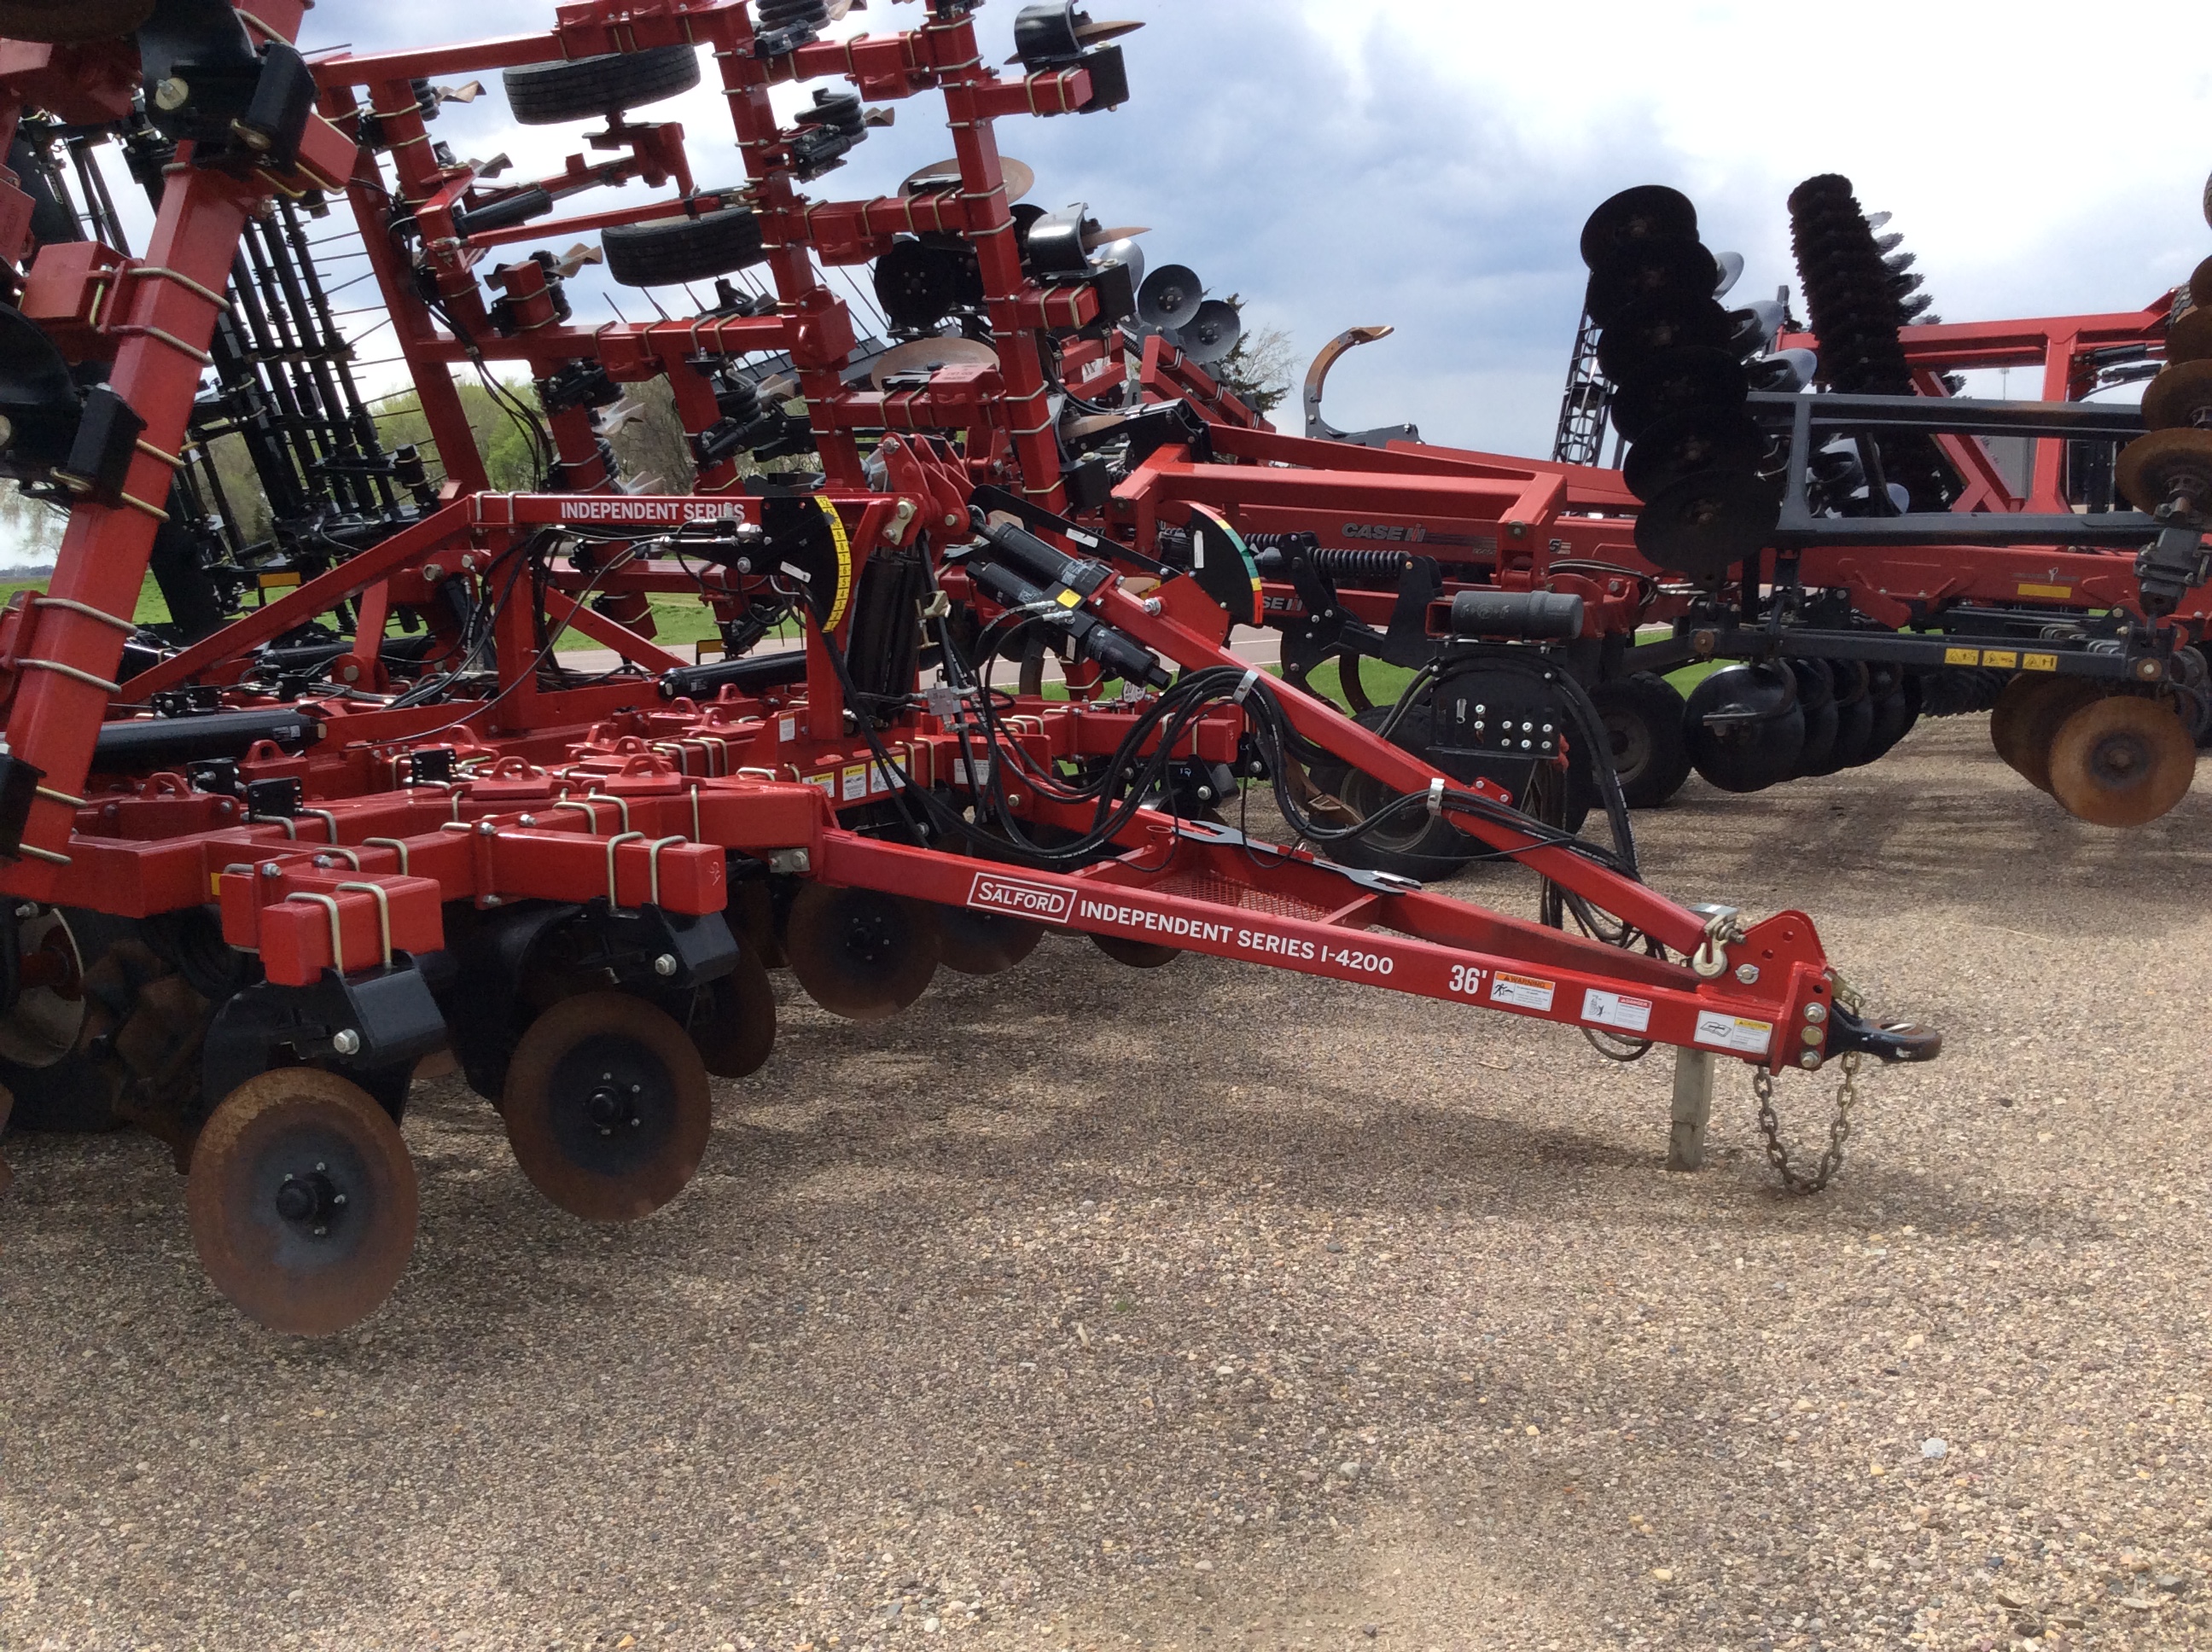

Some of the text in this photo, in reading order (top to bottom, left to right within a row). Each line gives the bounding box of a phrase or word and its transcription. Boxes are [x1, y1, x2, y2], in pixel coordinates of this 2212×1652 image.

[561, 502, 679, 520] INDEPENDENT
[1342, 522, 1404, 541] CASE
[978, 881, 1065, 913] SALFORD
[1080, 899, 1394, 974] INDEPENDENT SERIES I-4200
[1449, 964, 1487, 994] 36'
[1511, 976, 1545, 989] WARNING
[1625, 998, 1648, 1007] DANGER
